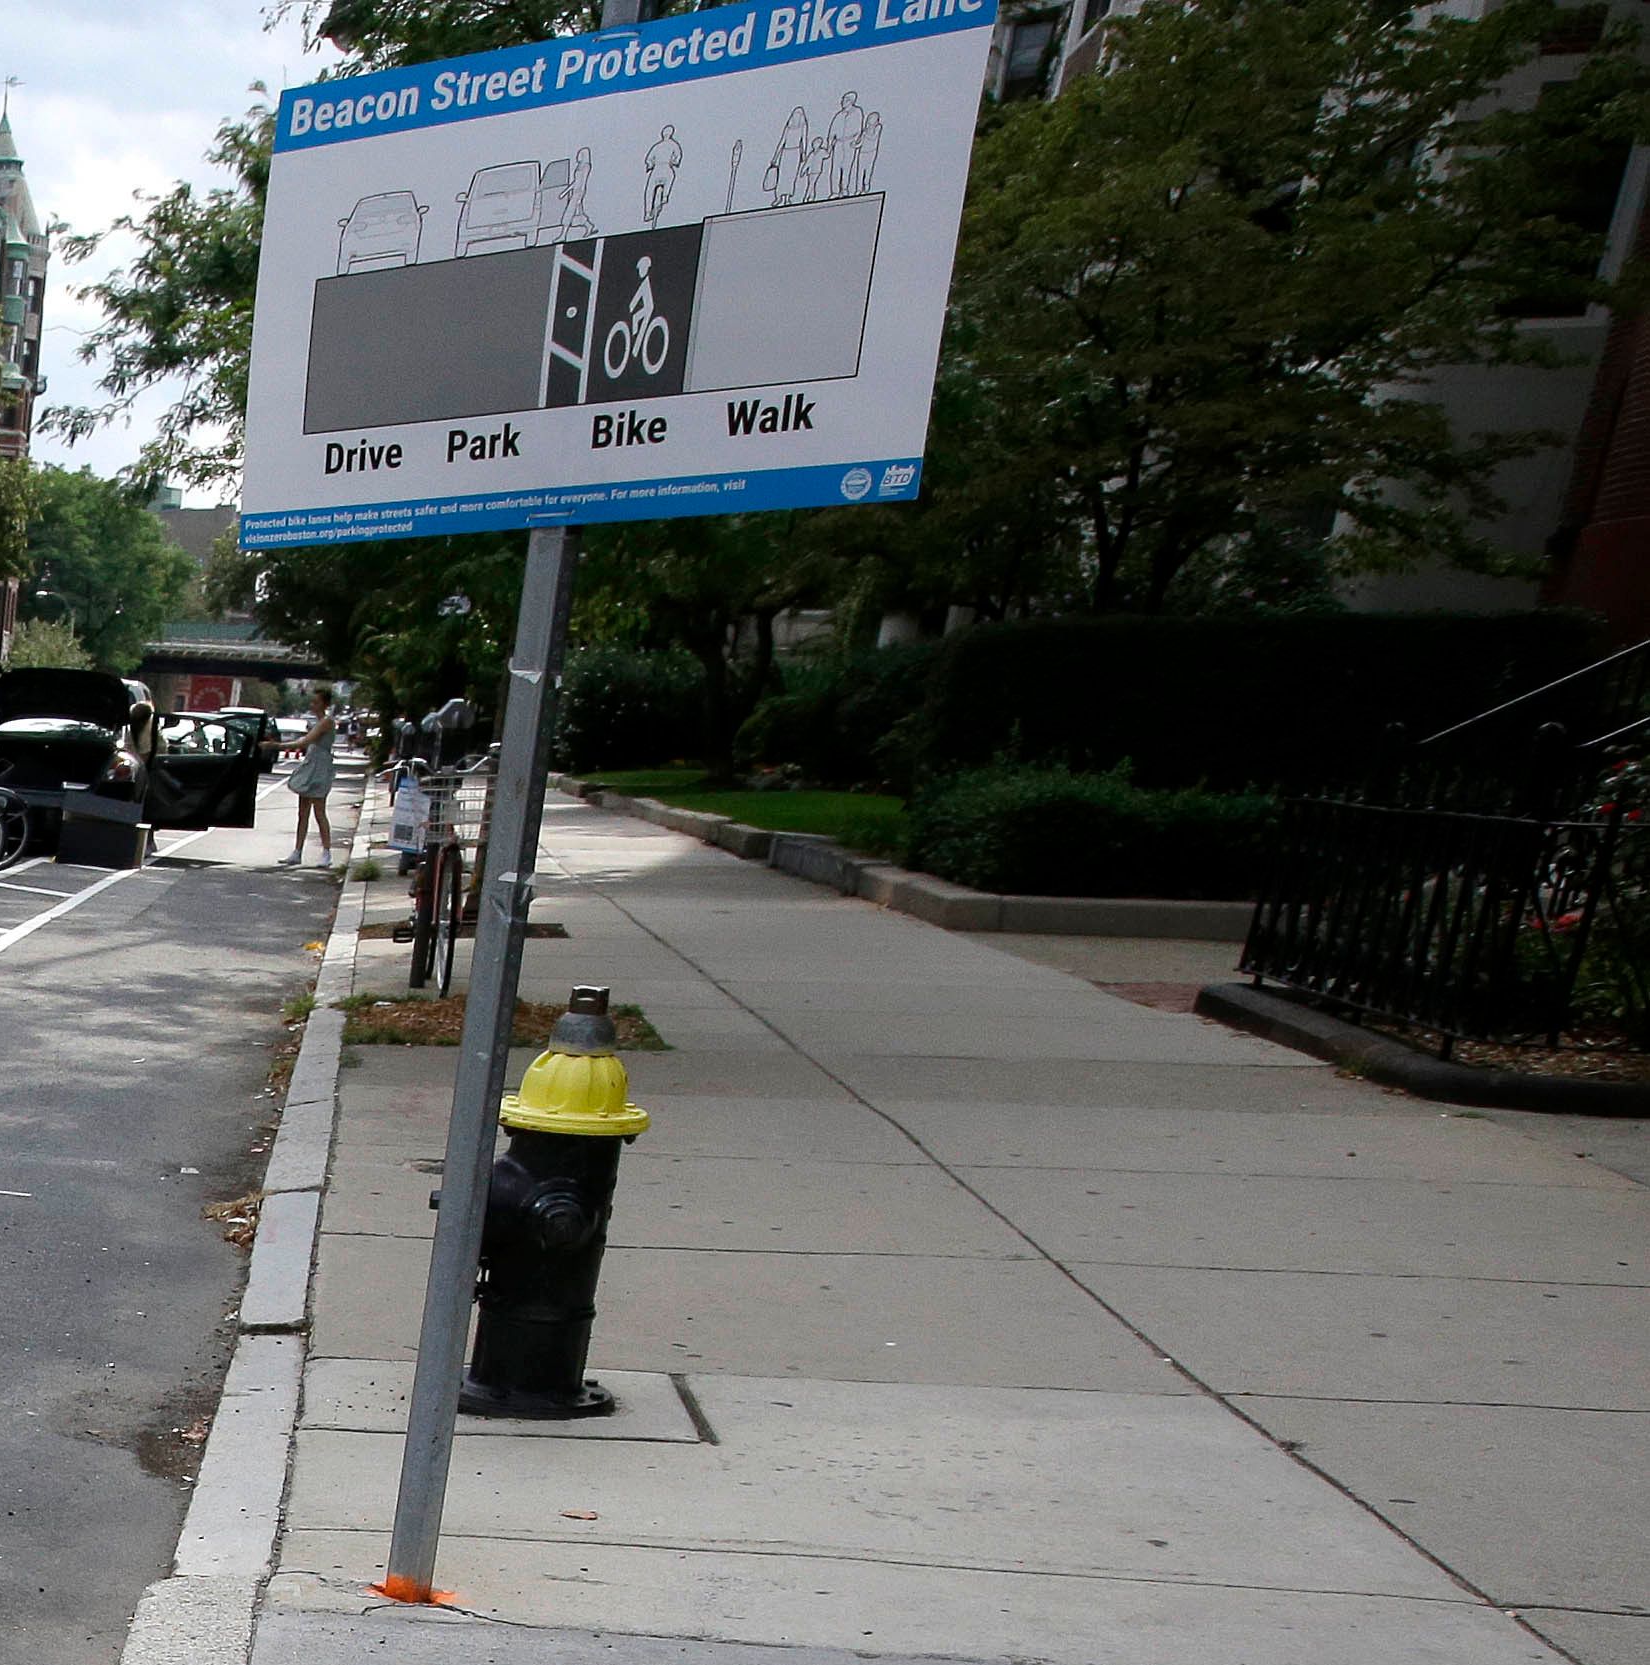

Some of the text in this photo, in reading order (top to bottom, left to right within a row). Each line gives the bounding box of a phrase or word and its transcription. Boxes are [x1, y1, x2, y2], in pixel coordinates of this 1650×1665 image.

[290, 87, 419, 137] Beacon
[431, 57, 547, 111] Street
[556, 11, 756, 89] Protected
[766, 0, 862, 51] Bike
[592, 410, 668, 450] Bike
[727, 393, 816, 437] Walk
[325, 440, 403, 475] Drive
[447, 422, 522, 464] Park
[245, 480, 747, 530] Protected bike lanes help make streets safer and more comfortable for everyone. For more information, visit
